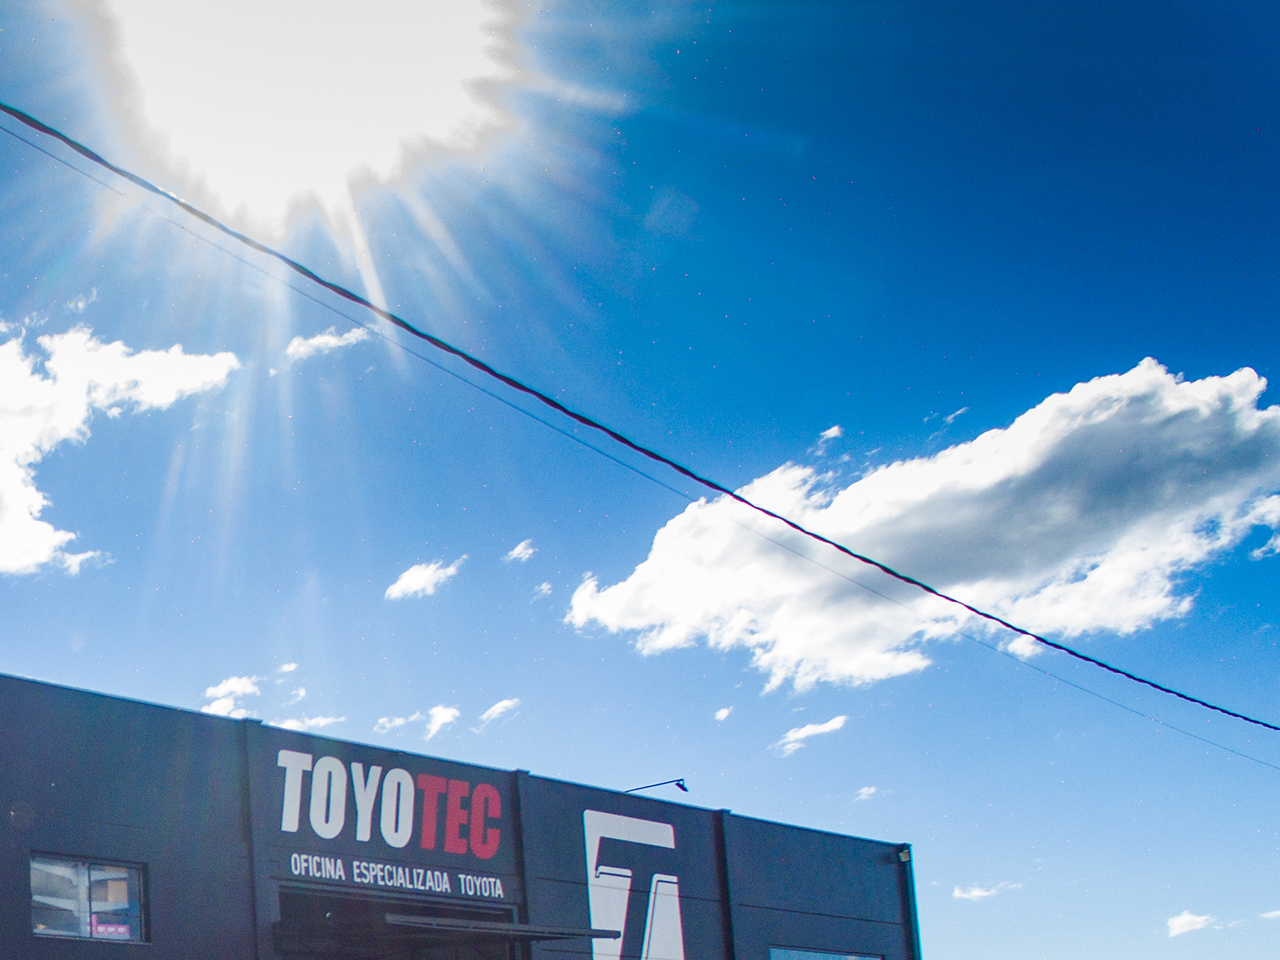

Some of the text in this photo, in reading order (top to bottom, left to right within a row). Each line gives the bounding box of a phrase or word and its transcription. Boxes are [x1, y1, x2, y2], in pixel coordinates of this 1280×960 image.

[277, 749, 502, 860] TOYOTEC
[291, 853, 504, 899] OFICINA ESPECIALIZADA TOYOTA
